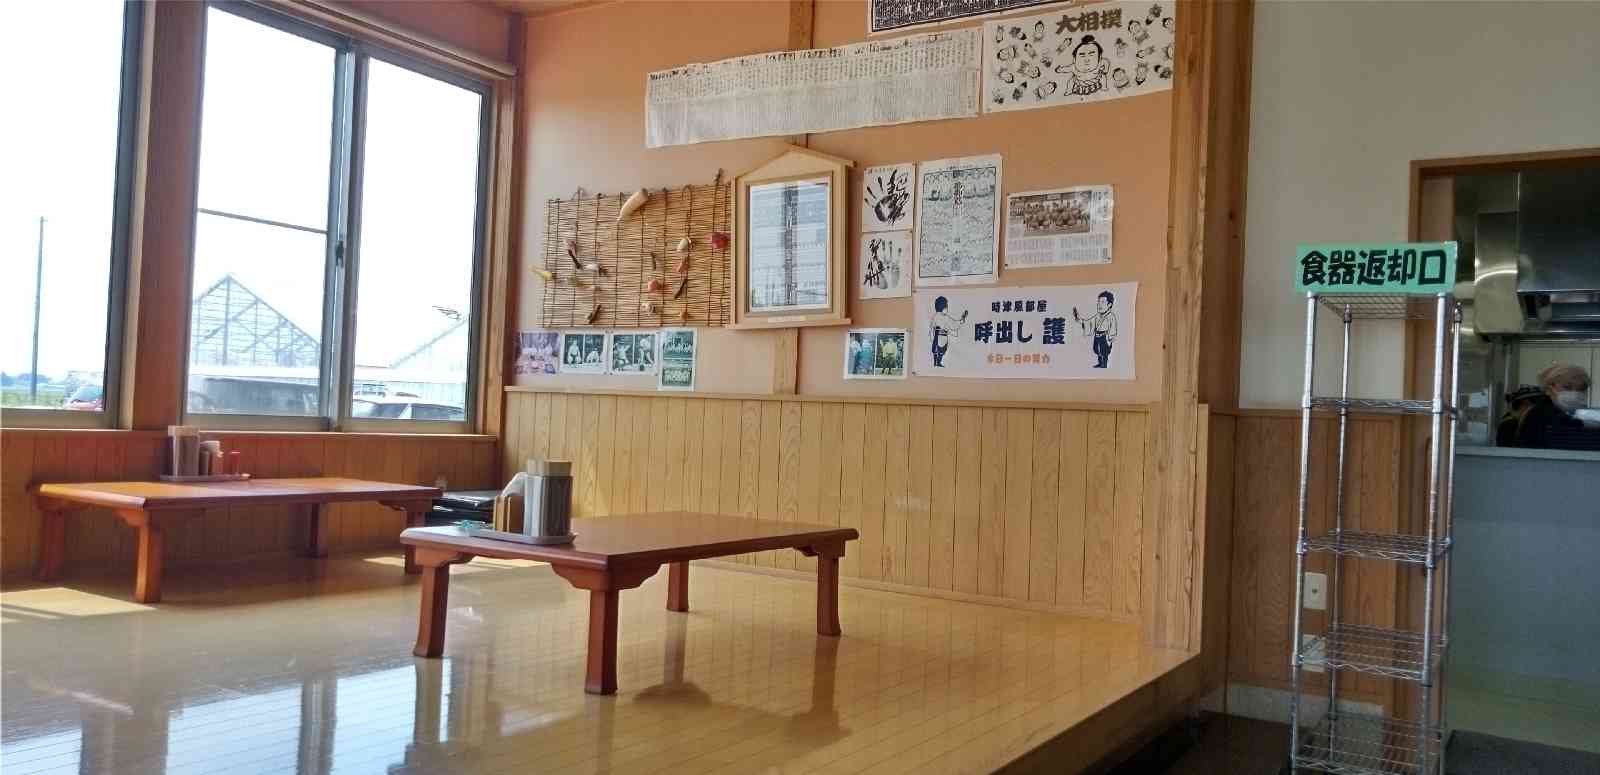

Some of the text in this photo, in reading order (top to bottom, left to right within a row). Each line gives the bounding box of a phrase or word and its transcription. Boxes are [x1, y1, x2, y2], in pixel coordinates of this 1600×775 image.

[1056, 8, 1122, 34] 大相撲
[1301, 249, 1446, 285] 食器返却口
[991, 299, 1047, 312] 時津風部屋
[974, 317, 1066, 345] 呼出し 護
